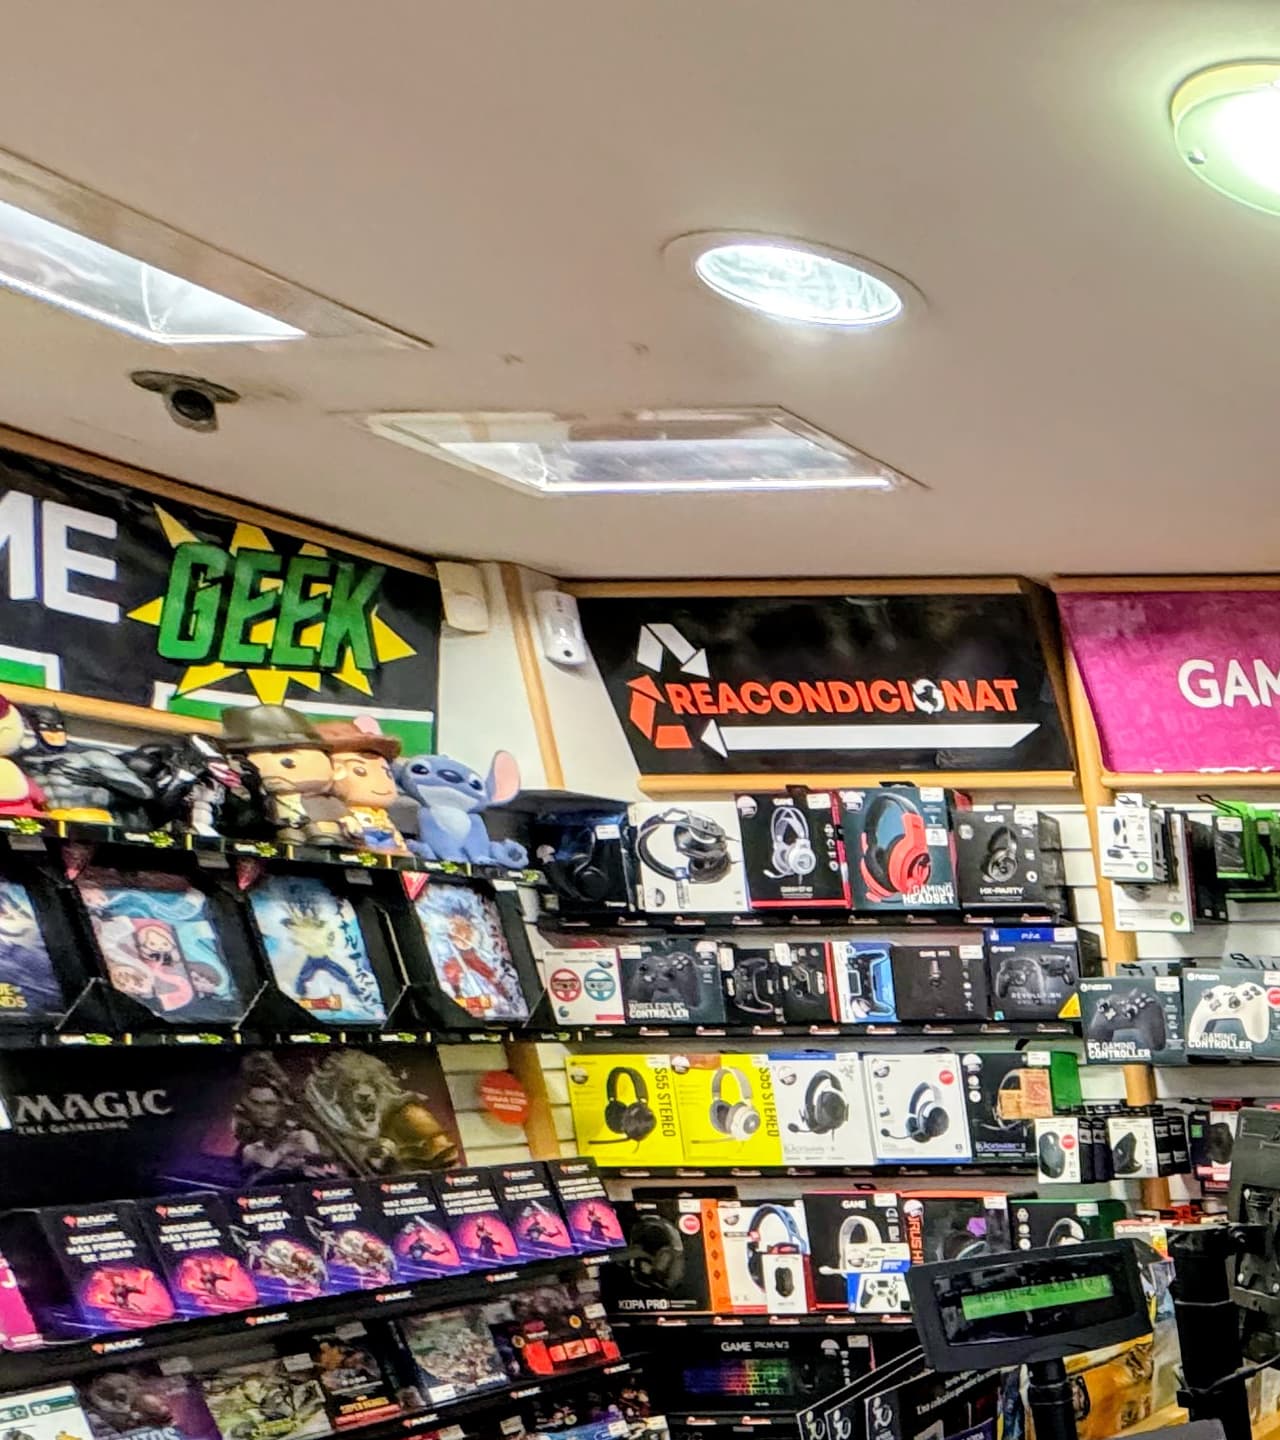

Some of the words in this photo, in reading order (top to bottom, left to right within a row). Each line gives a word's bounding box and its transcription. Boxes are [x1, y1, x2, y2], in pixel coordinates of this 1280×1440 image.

[158, 542, 388, 671] GEEK
[903, 893, 954, 905] HEADSET
[629, 1009, 690, 1019] CONTROLLER
[1188, 1039, 1252, 1050] CONTROLLER
[1088, 1048, 1151, 1058] CONTROLLER
[656, 1066, 668, 1088] S55
[15, 1089, 174, 1124] MAGIC
[658, 1093, 676, 1138] STEREO
[762, 1093, 779, 1138] STEREO
[618, 1299, 643, 1311] KOPA
[645, 1299, 668, 1310] PRO
[721, 1341, 752, 1352] GAME
